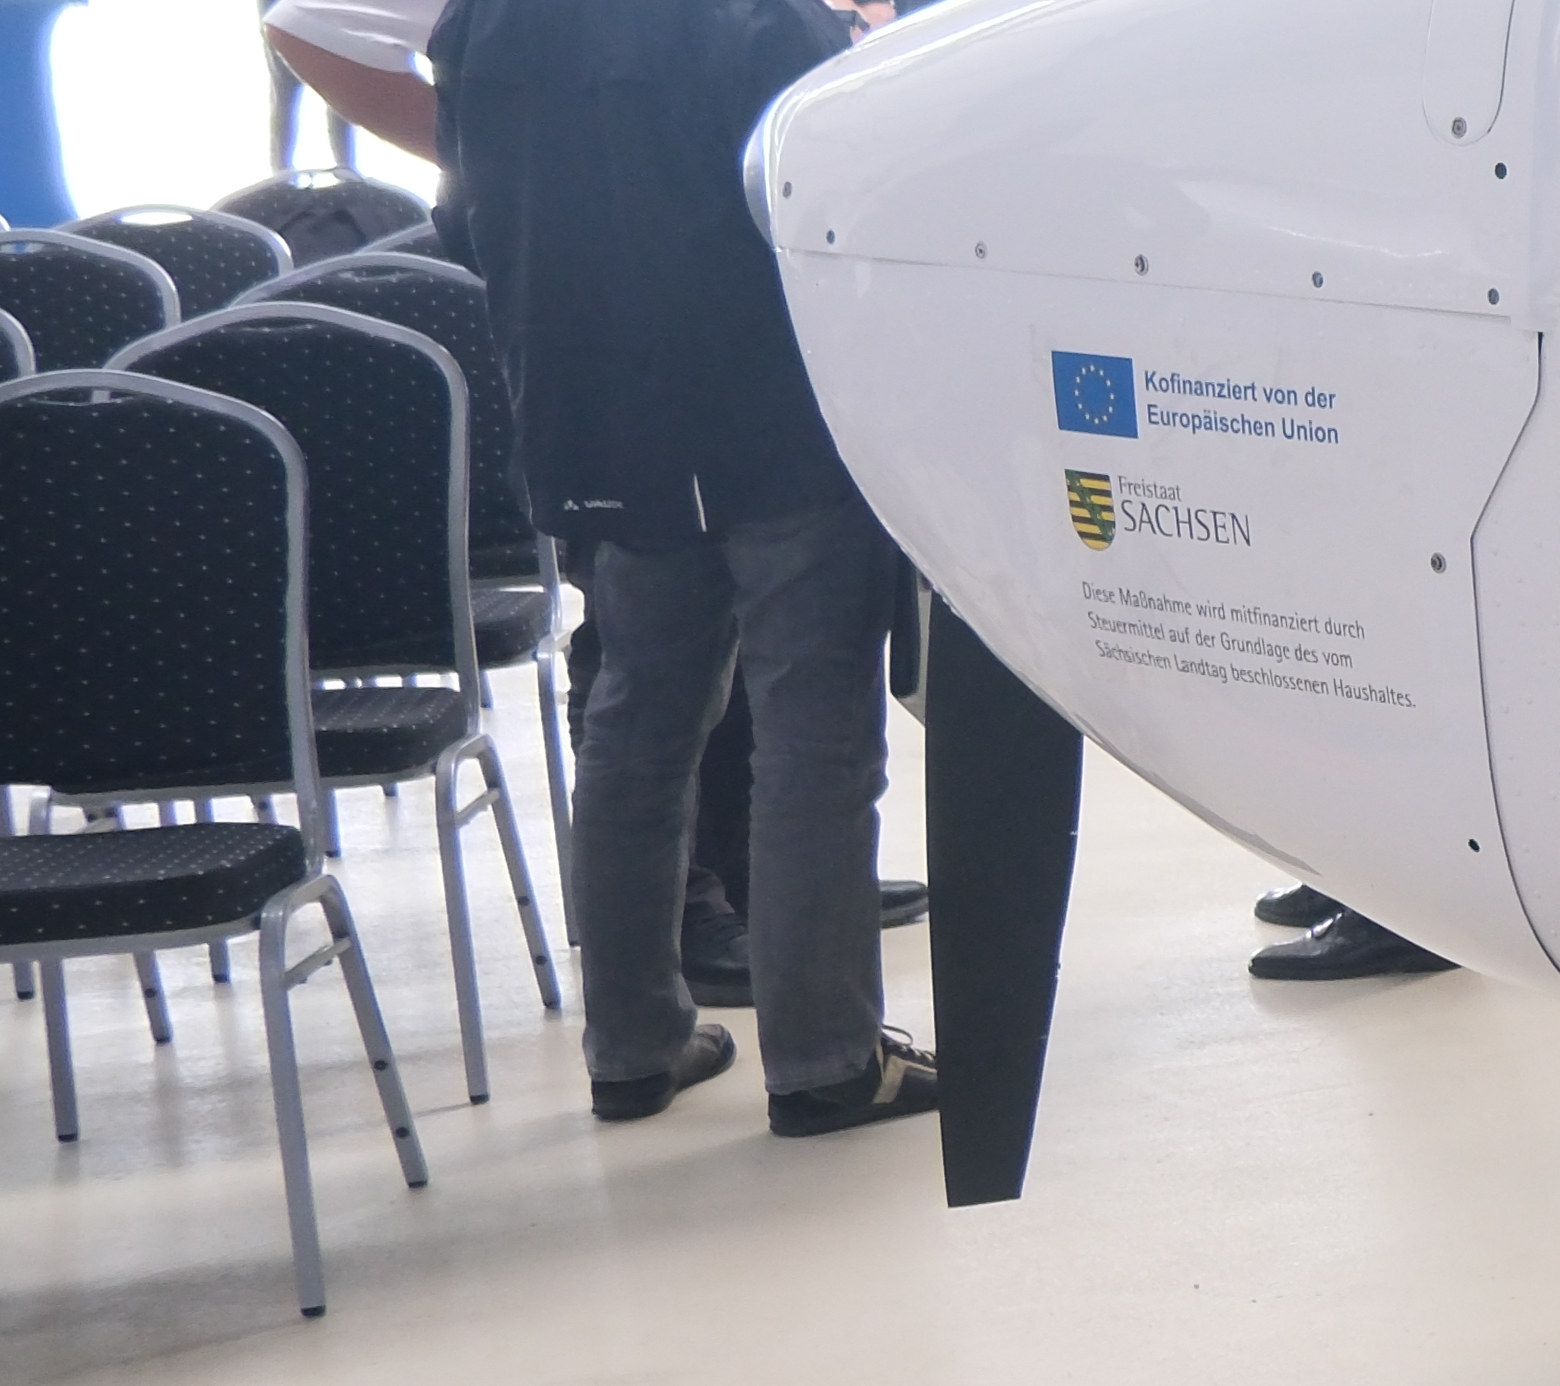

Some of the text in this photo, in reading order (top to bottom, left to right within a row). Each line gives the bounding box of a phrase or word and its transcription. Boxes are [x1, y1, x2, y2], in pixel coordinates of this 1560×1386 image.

[1144, 370, 1337, 409] Kofinanziert von der
[1146, 403, 1339, 444] Europäischen Union
[1117, 475, 1183, 502] Freistaat
[1120, 499, 1251, 547] SACHSEN
[1082, 580, 1366, 640] Diese Maßnahme wird mitfinanziert durch
[1088, 610, 1354, 669] Steuermittel auf der Grundlage des vom
[1095, 639, 1417, 708] Sächsischen Landtag beschlossenen Haushaltes.
